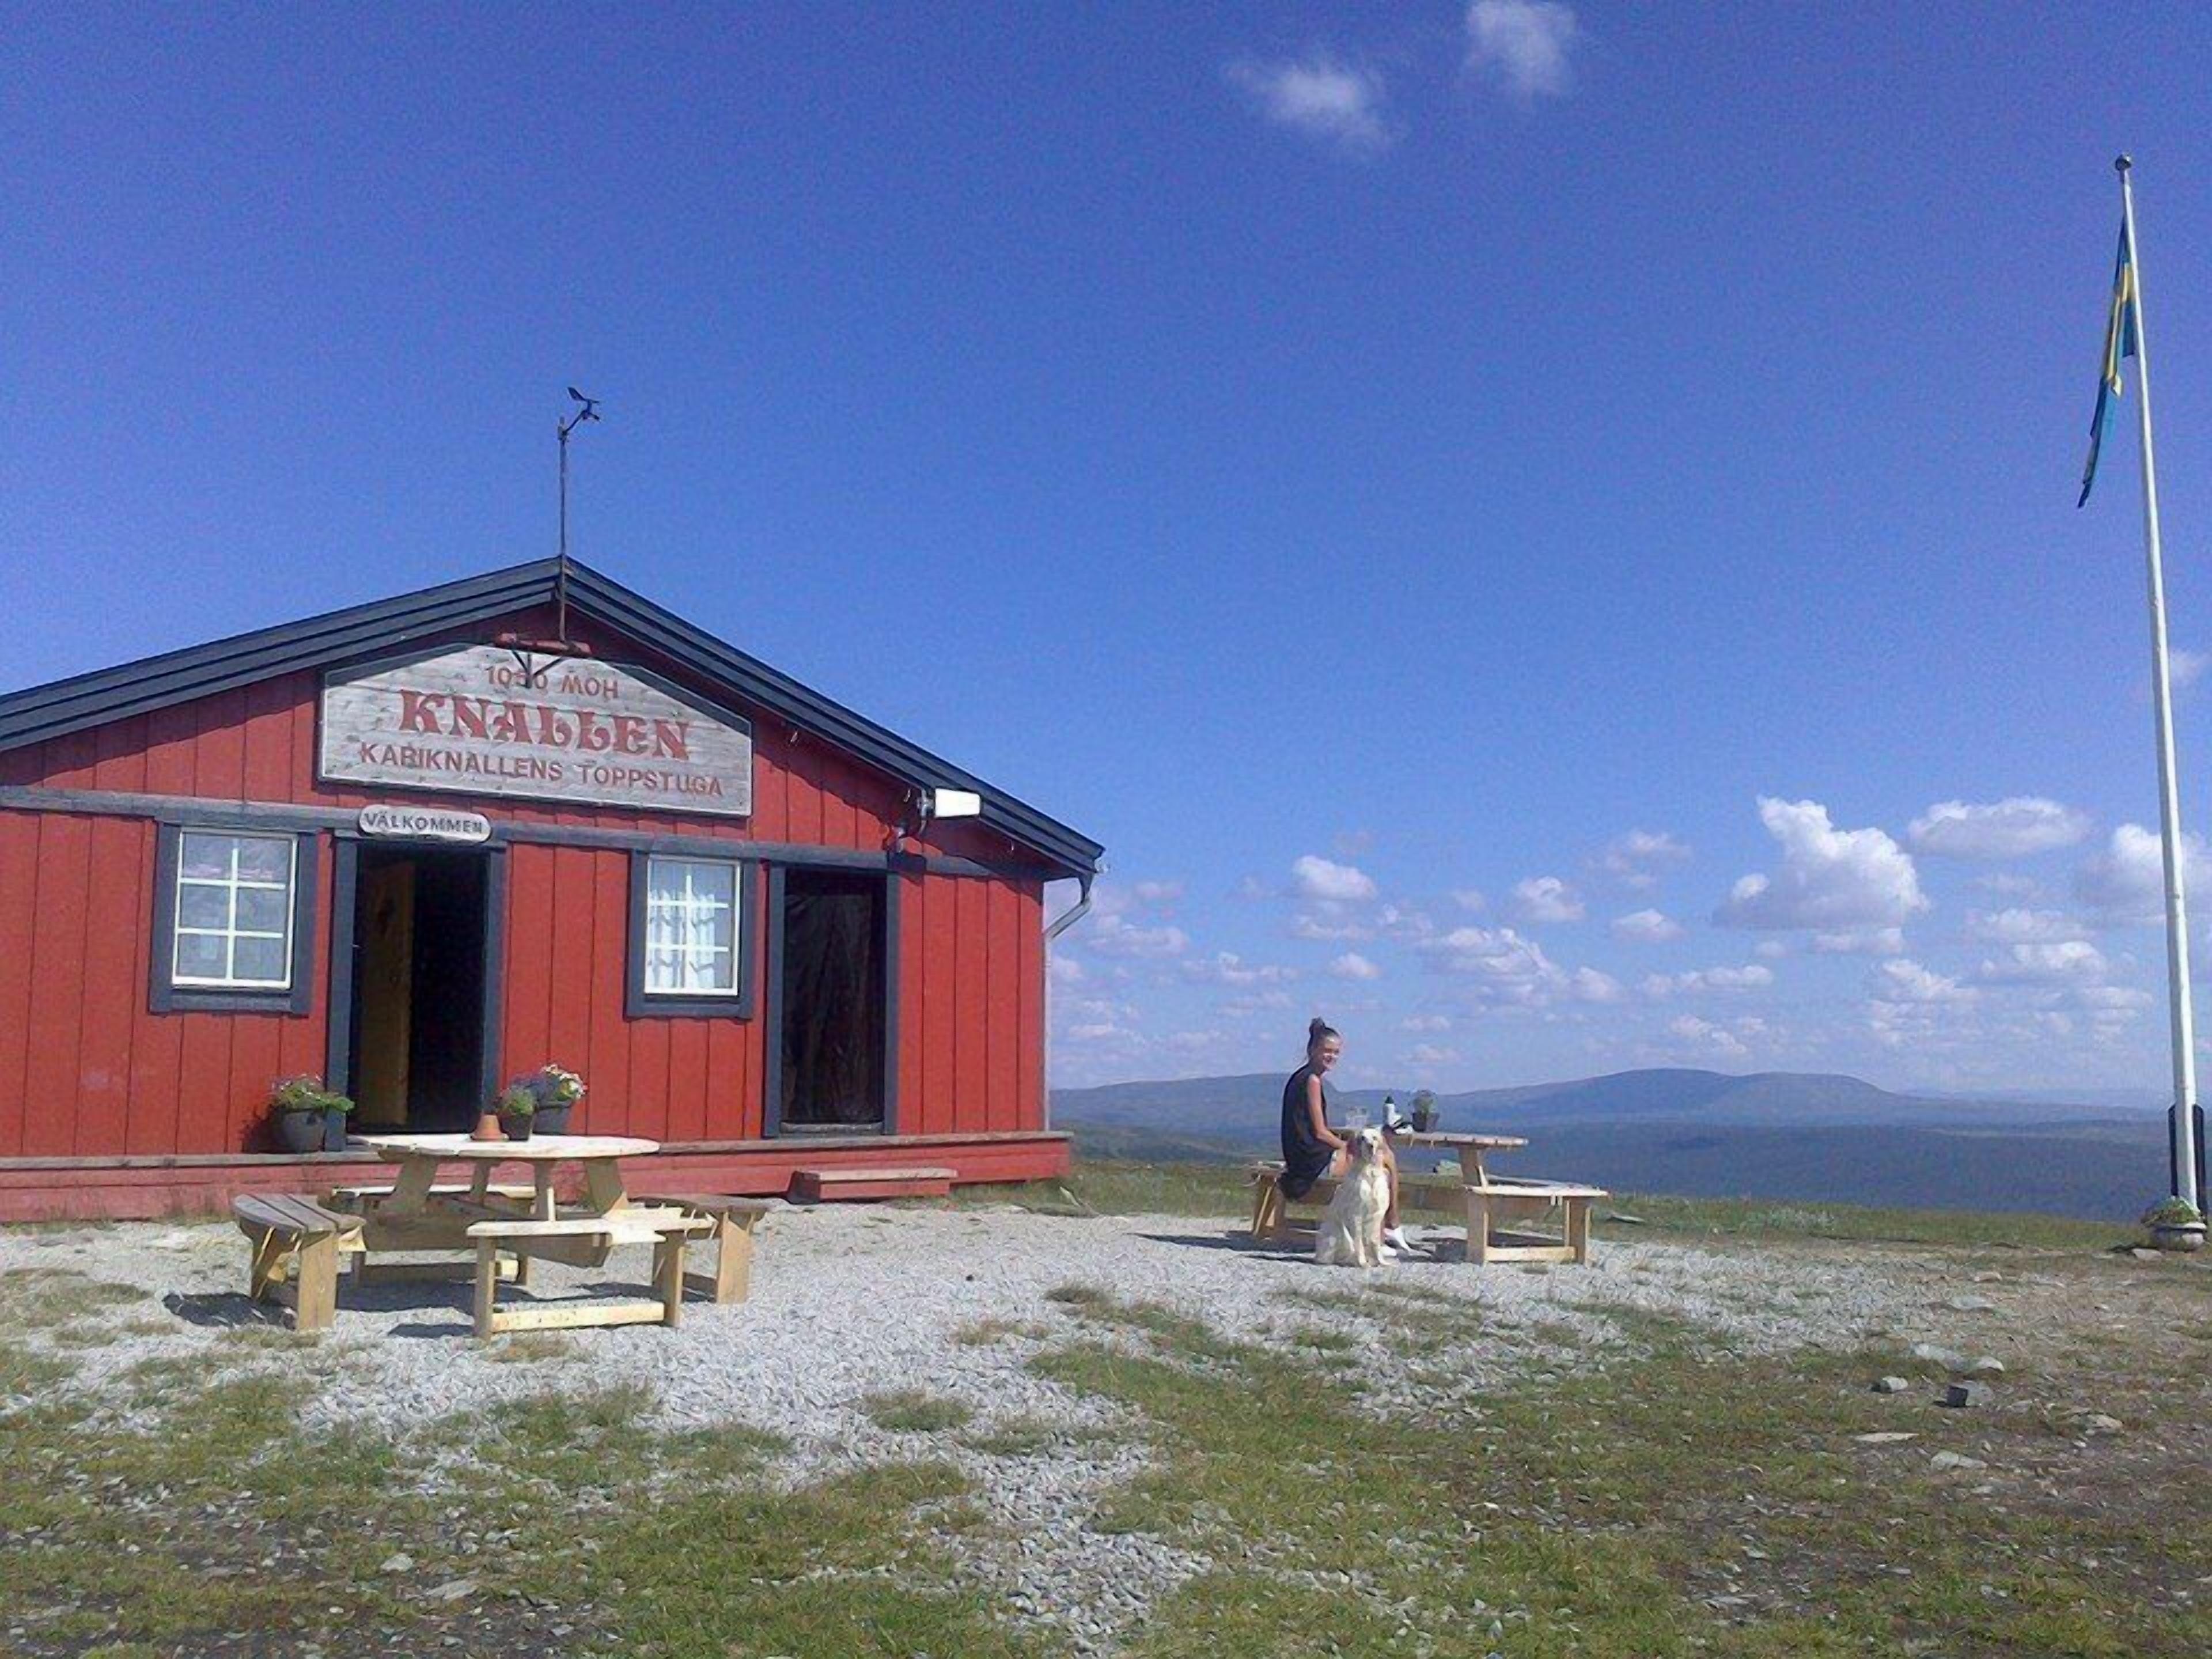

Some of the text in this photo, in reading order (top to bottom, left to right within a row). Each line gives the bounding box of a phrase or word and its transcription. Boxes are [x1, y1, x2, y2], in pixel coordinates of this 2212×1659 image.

[399, 690, 690, 761] KNALLEN
[577, 764, 723, 796] TOPPSTUGA
[364, 811, 482, 834] VÄLKOMMEN
